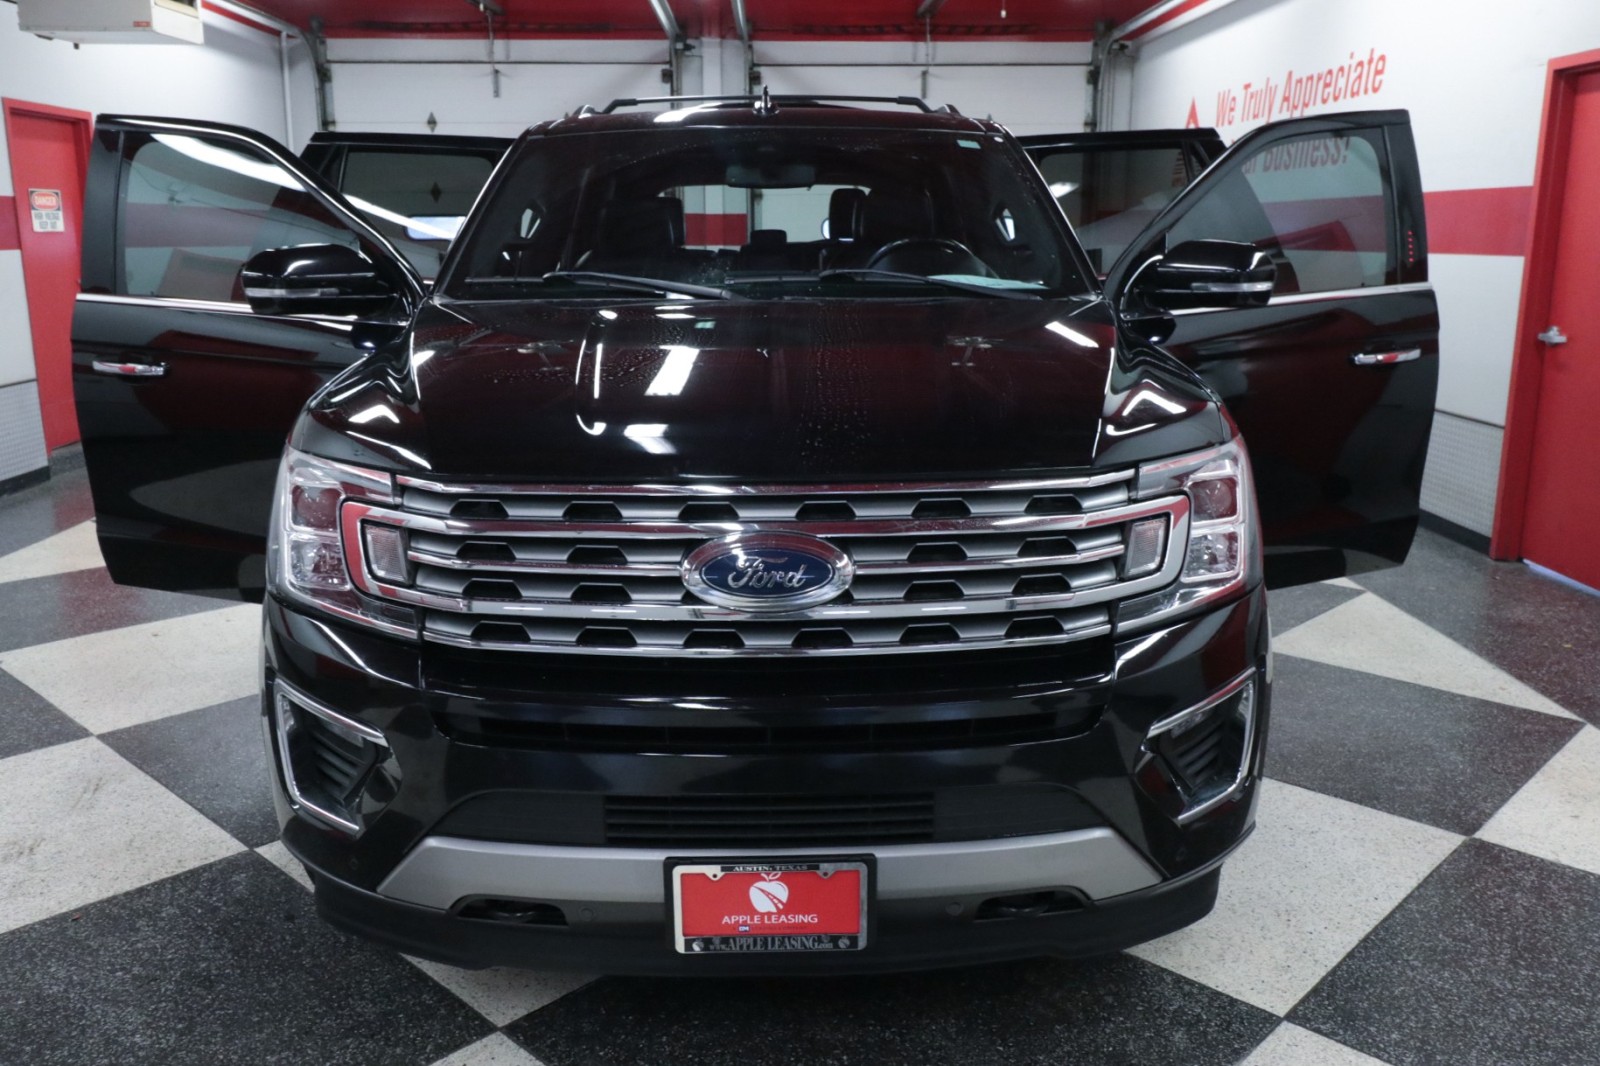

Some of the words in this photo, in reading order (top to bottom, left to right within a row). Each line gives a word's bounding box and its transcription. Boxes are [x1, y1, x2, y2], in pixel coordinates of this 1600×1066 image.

[1216, 90, 1236, 127] We
[1241, 78, 1278, 124] Truly
[1279, 48, 1387, 117] Appreciate
[727, 556, 807, 588] Ford
[722, 914, 762, 925] APPLE
[764, 913, 818, 924] LEASING
